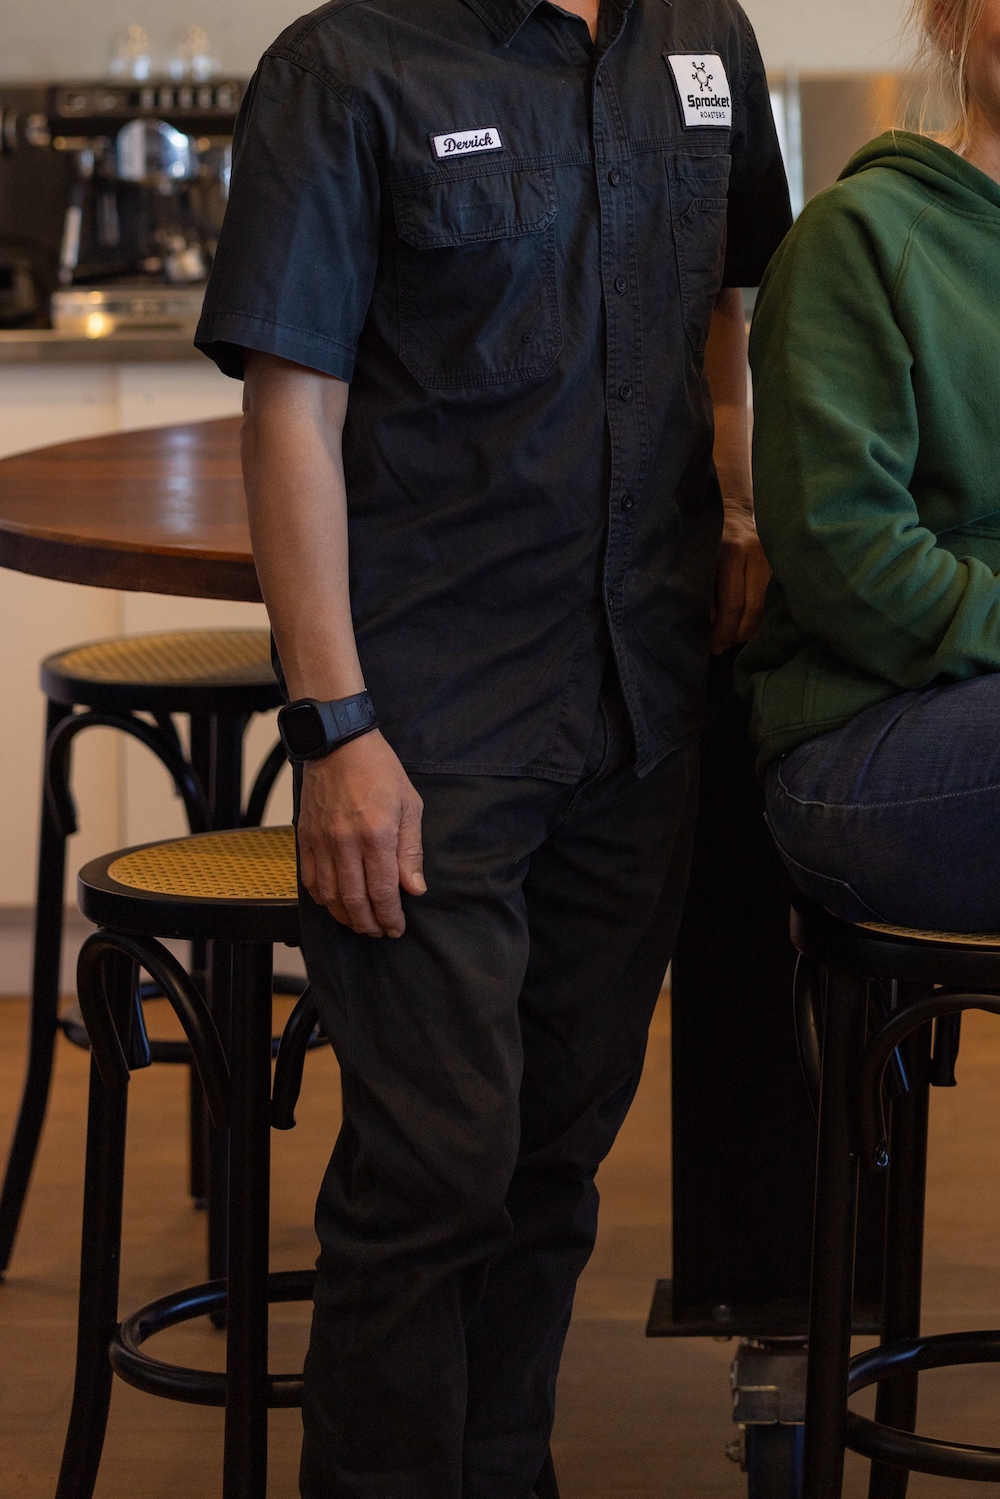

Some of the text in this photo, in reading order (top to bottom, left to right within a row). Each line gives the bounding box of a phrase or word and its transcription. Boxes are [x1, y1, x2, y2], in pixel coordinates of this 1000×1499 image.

[687, 94, 730, 110] Sprocket
[700, 111, 726, 119] ROASTERS
[443, 132, 494, 153] Derrick
